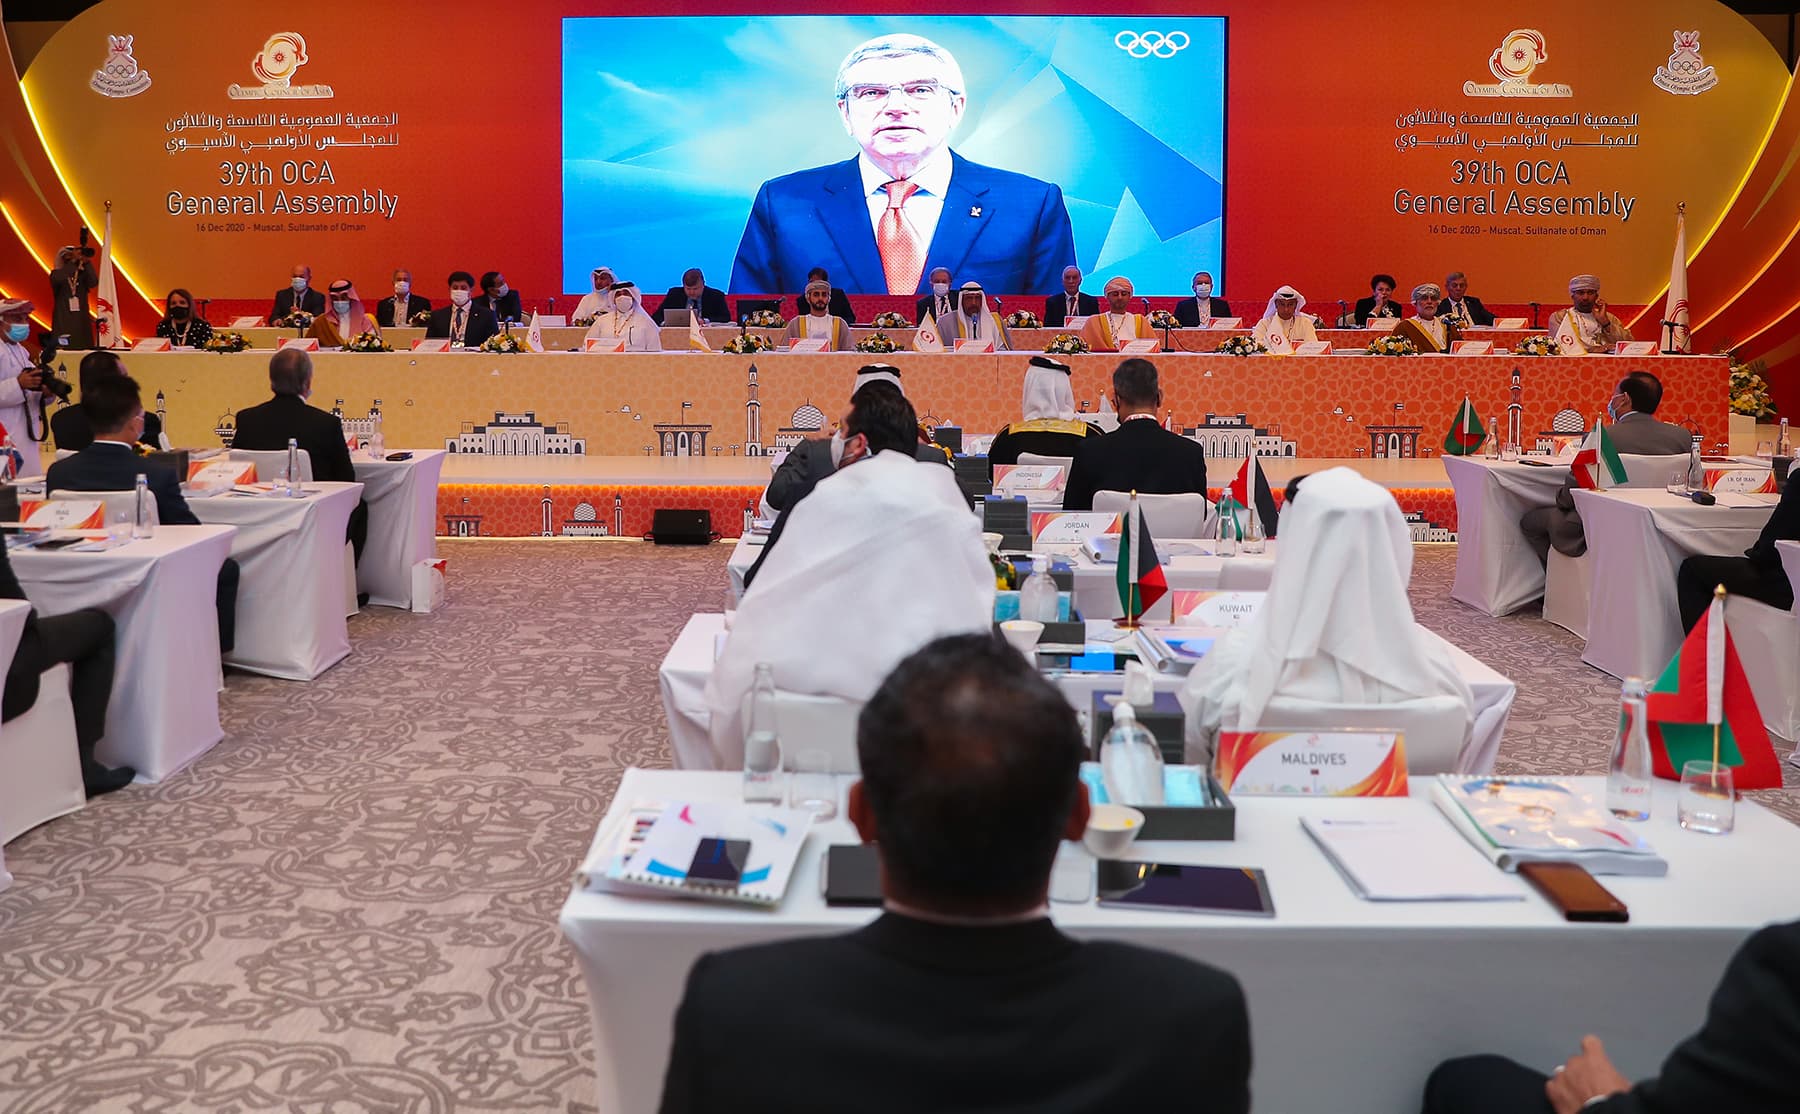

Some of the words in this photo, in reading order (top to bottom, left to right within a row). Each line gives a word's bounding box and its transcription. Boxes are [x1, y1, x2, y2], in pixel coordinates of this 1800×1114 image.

[164, 112, 223, 132] والثلاثون
[226, 112, 276, 128] التاسعة
[278, 112, 342, 130] العمومية
[345, 112, 398, 128] الجمعية
[1395, 108, 1456, 128] والثلاثون
[1459, 112, 1512, 127] التاسعة
[1515, 112, 1580, 129] العمومية
[1583, 112, 1639, 129] الجمعية
[218, 160, 273, 186] 39th
[281, 160, 336, 186] OCA
[1451, 160, 1506, 186] 39th
[1515, 160, 1571, 186] OCA
[166, 190, 265, 216] General
[272, 188, 398, 220] Assembly
[1393, 189, 1497, 216] General
[1504, 190, 1636, 222] Assembly
[196, 223, 206, 232] 16
[207, 223, 224, 232] Dec
[226, 223, 245, 232] 2020
[288, 223, 328, 232] Sultanate
[330, 223, 340, 232] of
[340, 224, 366, 232] Oman
[1428, 225, 1438, 234] 16
[1440, 225, 1458, 234] Dec
[1460, 226, 1480, 234] 2020
[1526, 226, 1568, 236] Sultanate
[1569, 226, 1578, 236] of
[1580, 226, 1606, 236] Oman
[1219, 604, 1252, 613] KUWAIT
[1281, 752, 1346, 766] MALDIVES
